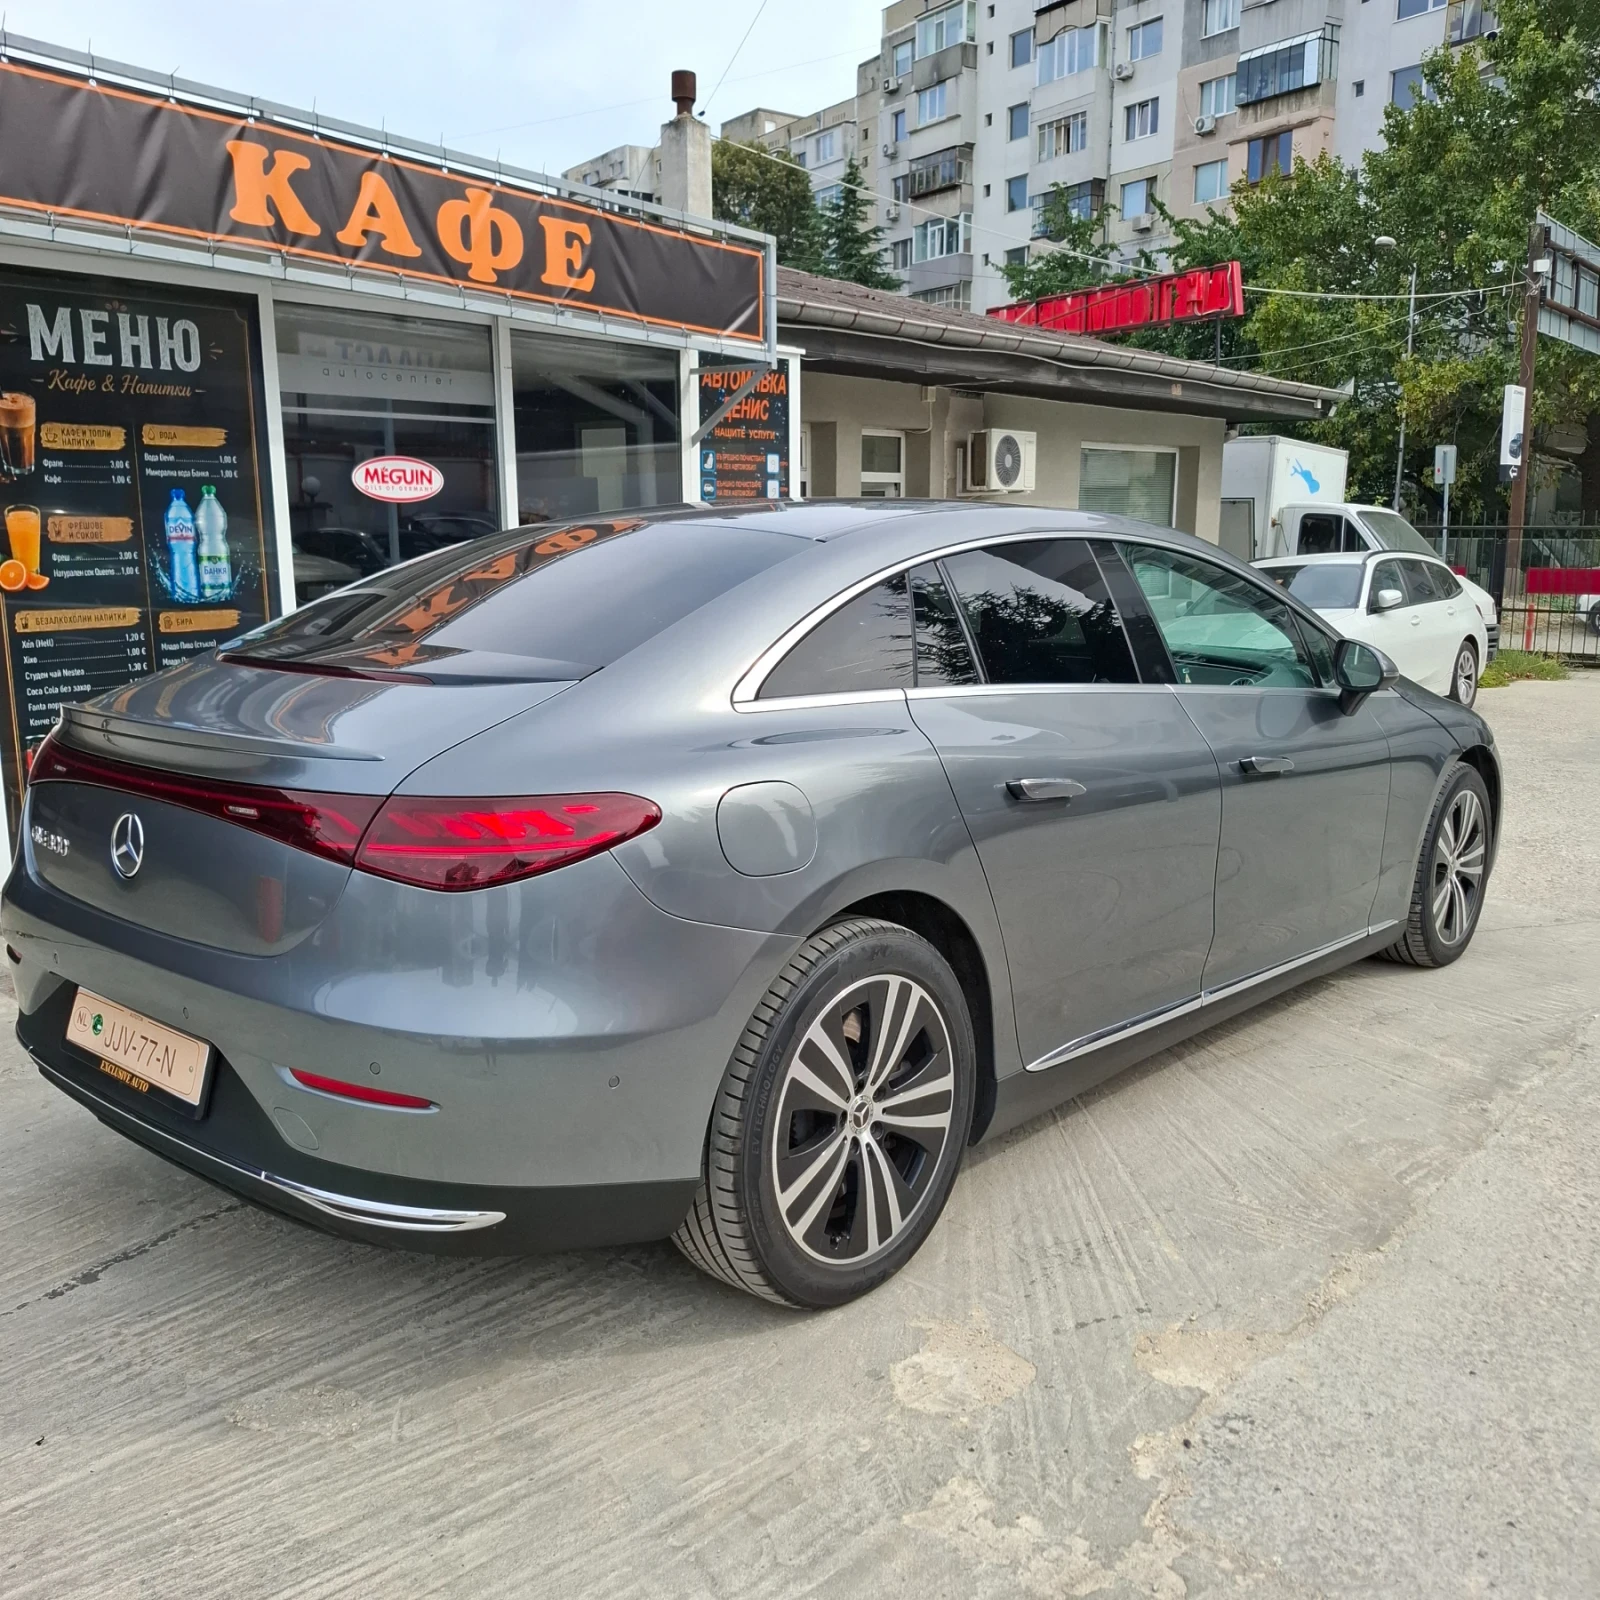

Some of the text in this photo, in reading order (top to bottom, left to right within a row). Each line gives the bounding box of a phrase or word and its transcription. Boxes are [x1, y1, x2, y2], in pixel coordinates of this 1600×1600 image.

[225, 140, 596, 293] КАФЕ
[26, 303, 201, 372] МЕНЮ
[322, 367, 452, 385] autocenter
[48, 369, 192, 397] Кафе & Напитки
[701, 370, 787, 395] АВТОМВКА
[61, 427, 112, 439] КАФЕ И ТОПЛИ
[159, 431, 177, 440] ВОДА
[714, 427, 776, 440] НАШИТЕ УСЛУГИ
[62, 438, 95, 448] НАПИТКИ
[42, 458, 64, 469] Фрапе
[44, 474, 62, 485] Кафе
[68, 521, 104, 530] ФРЕШОВЕ
[169, 522, 193, 534] DEVIN
[69, 531, 104, 540] И СОКОВЕ
[52, 551, 138, 563] Фреш 3,00 €
[121, 566, 134, 576] 1,00
[134, 566, 140, 575] €
[35, 612, 127, 626] БЕЗАЛКОХОЛНИ НАПИТКИ
[176, 618, 194, 627] БИРА
[125, 632, 139, 642] 1,20
[140, 632, 145, 641] €
[127, 647, 140, 656] 1,00
[141, 647, 146, 656] €
[25, 662, 148, 681] Студен чай Nestea 1,30 €
[26, 683, 92, 696] Coca Cola без захар
[28, 701, 46, 711] Fanta
[77, 1011, 88, 1027] NL
[104, 1021, 177, 1078] JJV-77-N
[100, 1060, 149, 1093] EXCLUSIVE AUTO
[751, 1043, 784, 1155] EV TECHNOLOGY
